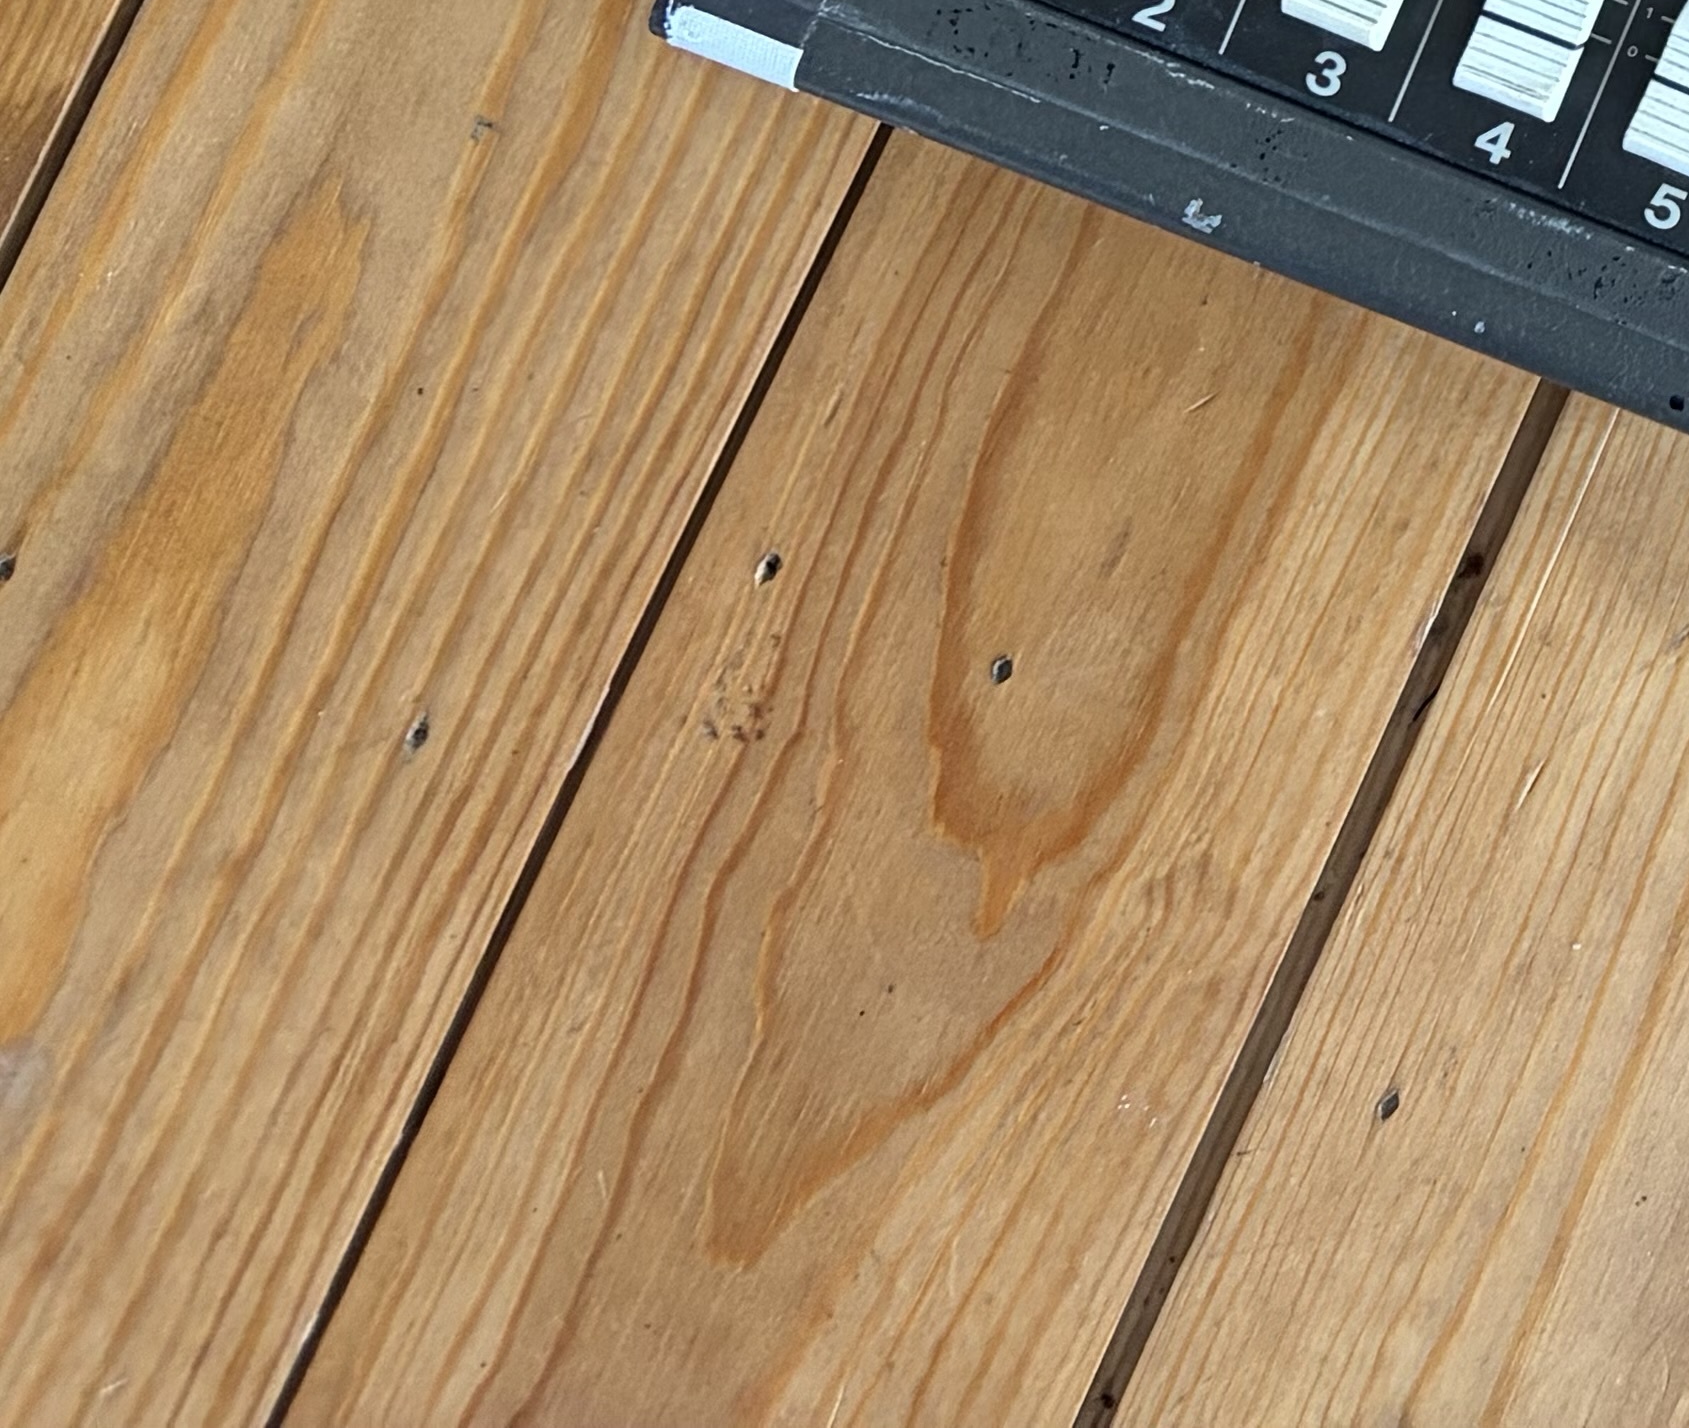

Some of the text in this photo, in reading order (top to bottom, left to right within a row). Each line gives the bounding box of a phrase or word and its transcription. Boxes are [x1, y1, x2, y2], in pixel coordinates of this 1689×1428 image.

[1305, 50, 1347, 97] 3
[1474, 121, 1516, 165] 4
[1643, 182, 1689, 230] 5
